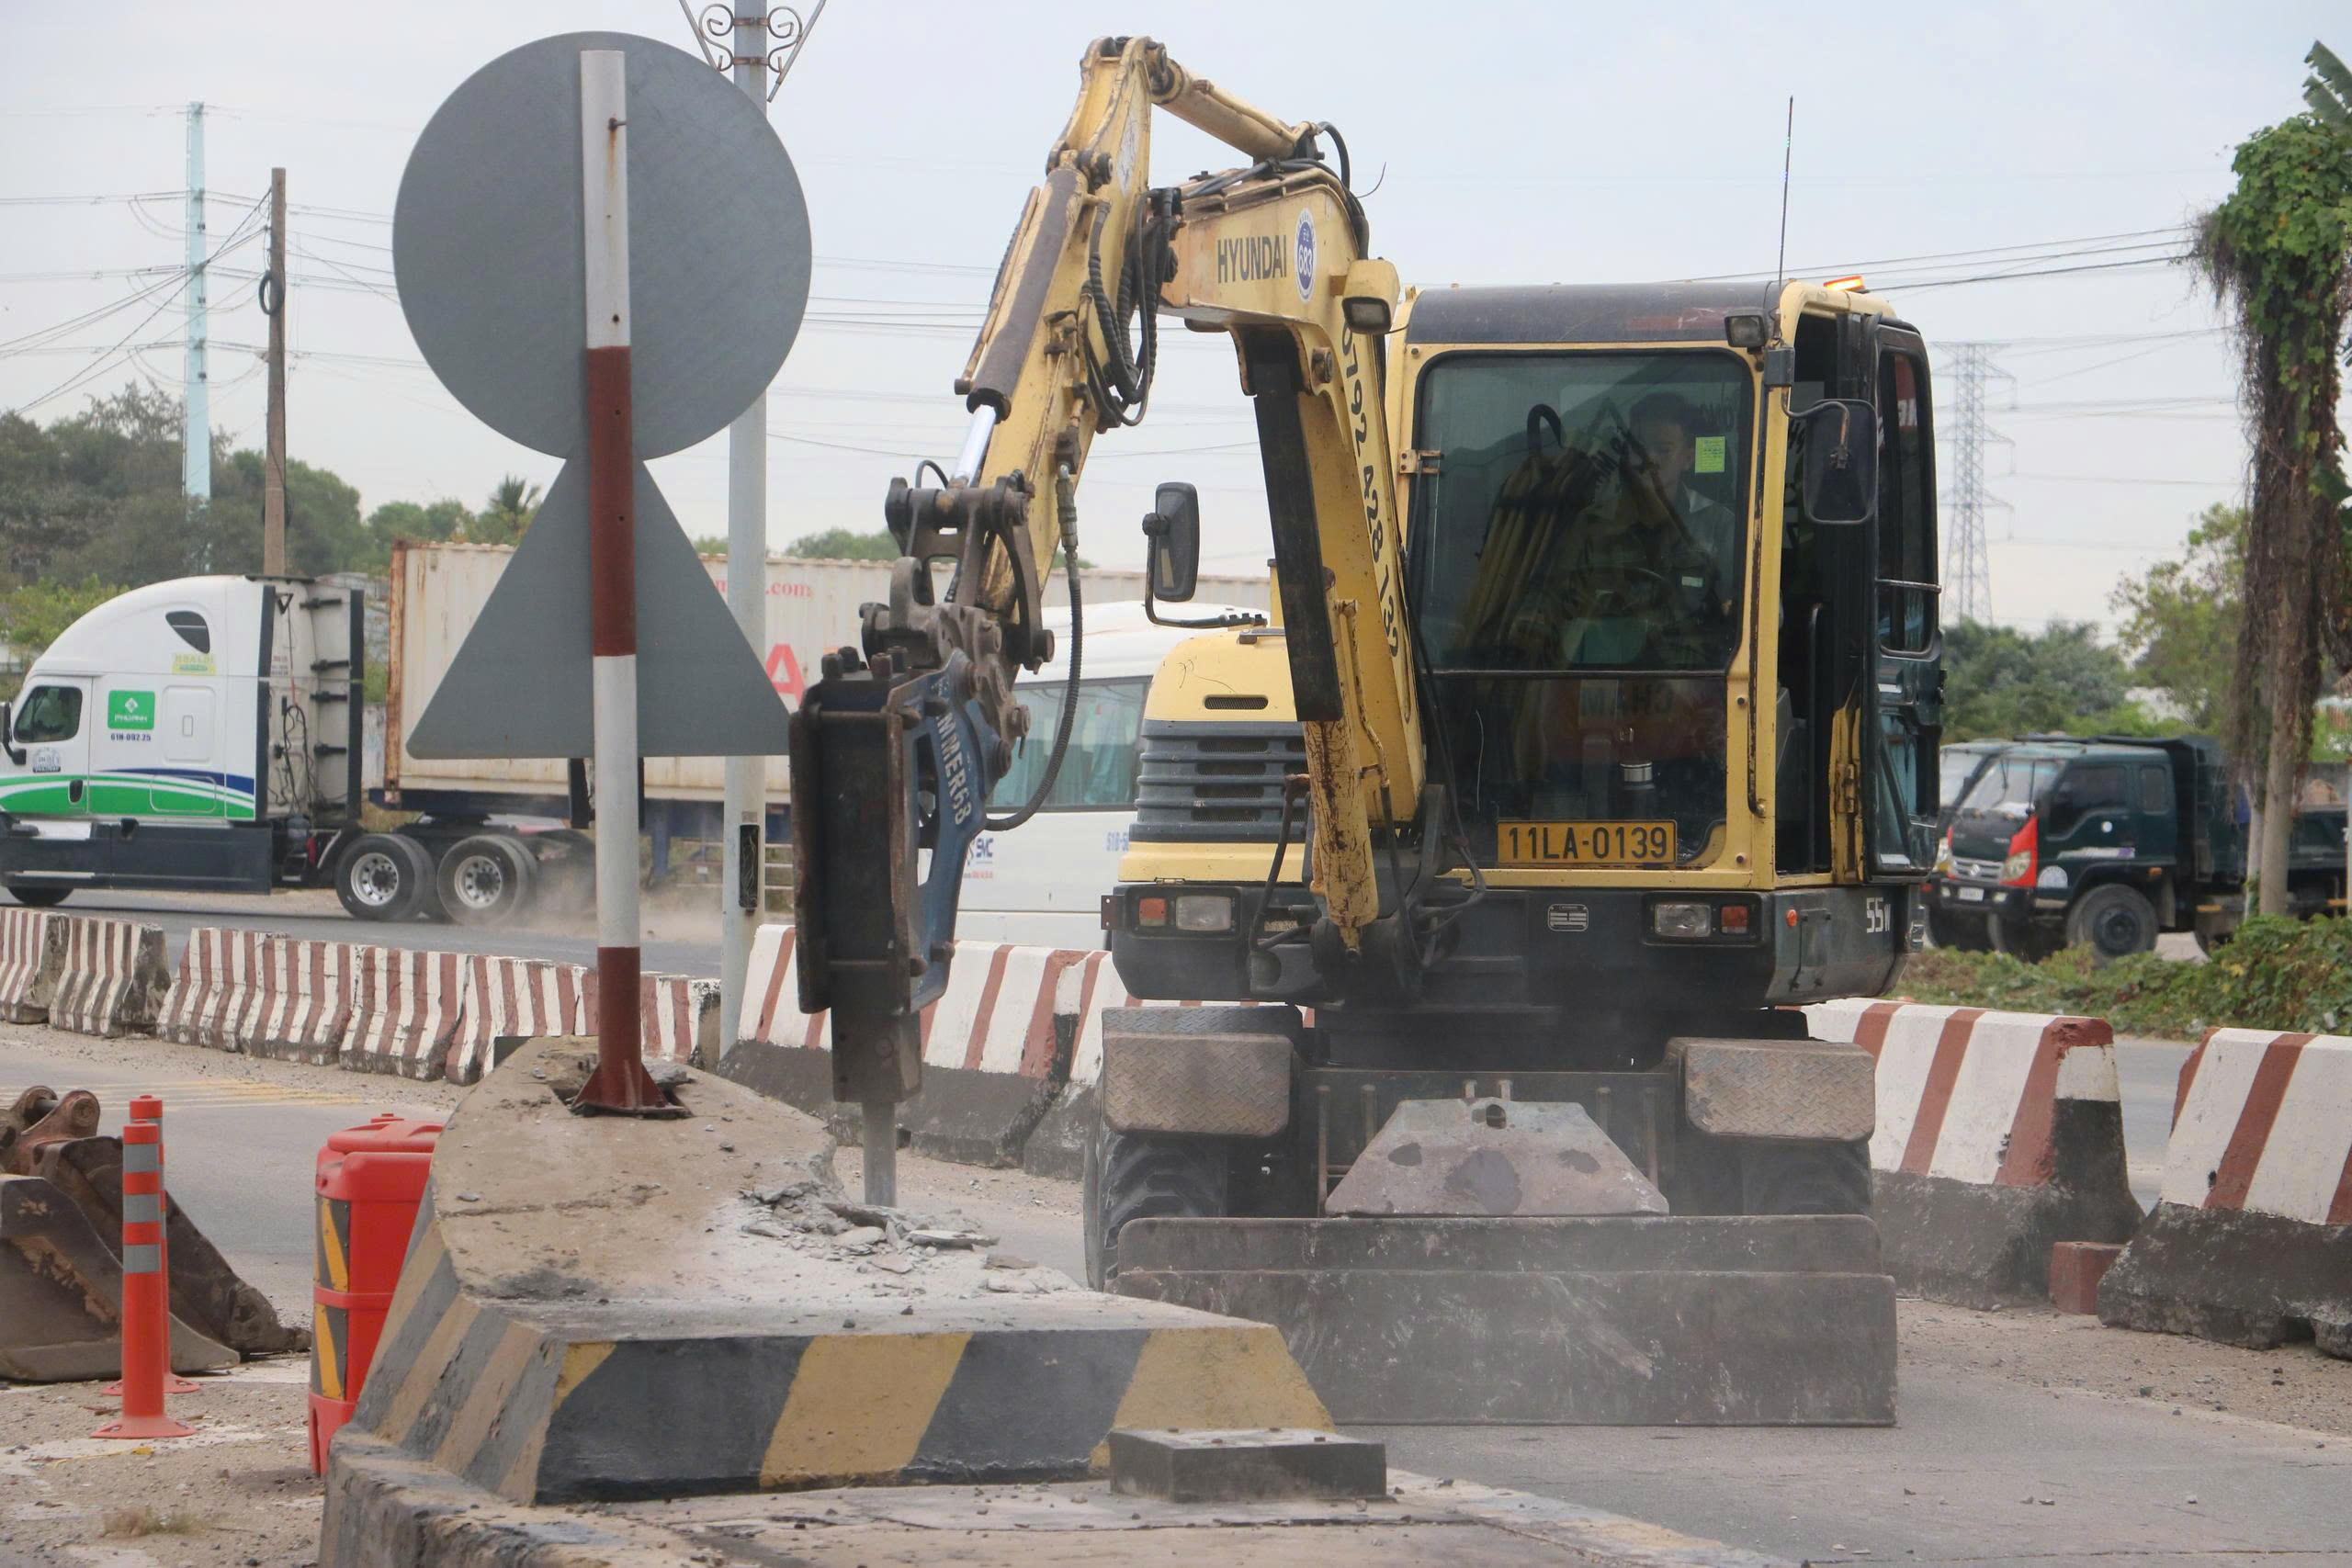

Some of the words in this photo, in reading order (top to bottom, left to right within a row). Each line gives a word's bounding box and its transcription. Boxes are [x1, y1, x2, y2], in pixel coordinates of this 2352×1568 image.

[1217, 235, 1287, 284] HYUNDAI
[1298, 243, 1314, 277] 683
[933, 678, 972, 825] MMER68
[1509, 827, 1668, 859] 11LA-0139
